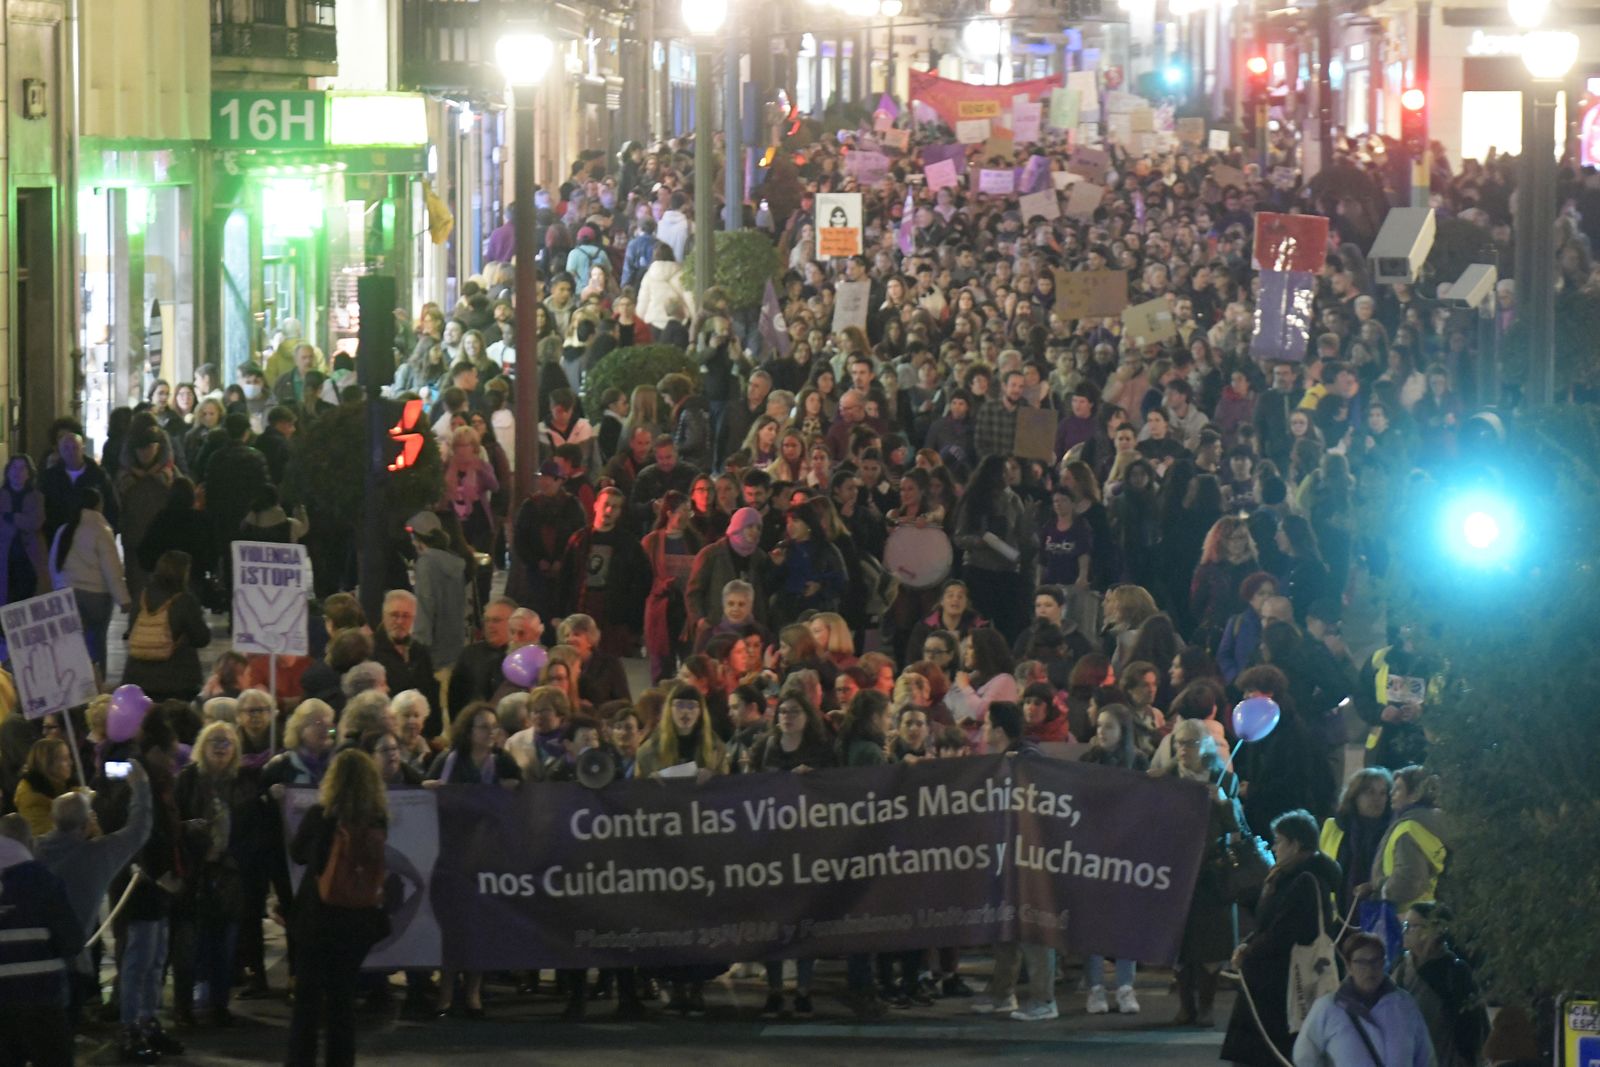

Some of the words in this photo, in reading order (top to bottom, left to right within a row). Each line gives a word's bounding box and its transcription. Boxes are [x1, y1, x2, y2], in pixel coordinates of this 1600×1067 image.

[219, 98, 315, 141] 16H
[239, 545, 302, 565] VIOLENCIA
[570, 807, 682, 841] Contra
[691, 800, 736, 834] las
[743, 791, 909, 832] Violencias
[917, 776, 1081, 828] Machistas,
[477, 871, 535, 897] nos
[543, 860, 715, 897] Cuidamos,
[724, 860, 784, 888] nos
[792, 842, 991, 885] Levantamos
[996, 842, 1007, 876] y
[1014, 834, 1172, 890] Luchamos
